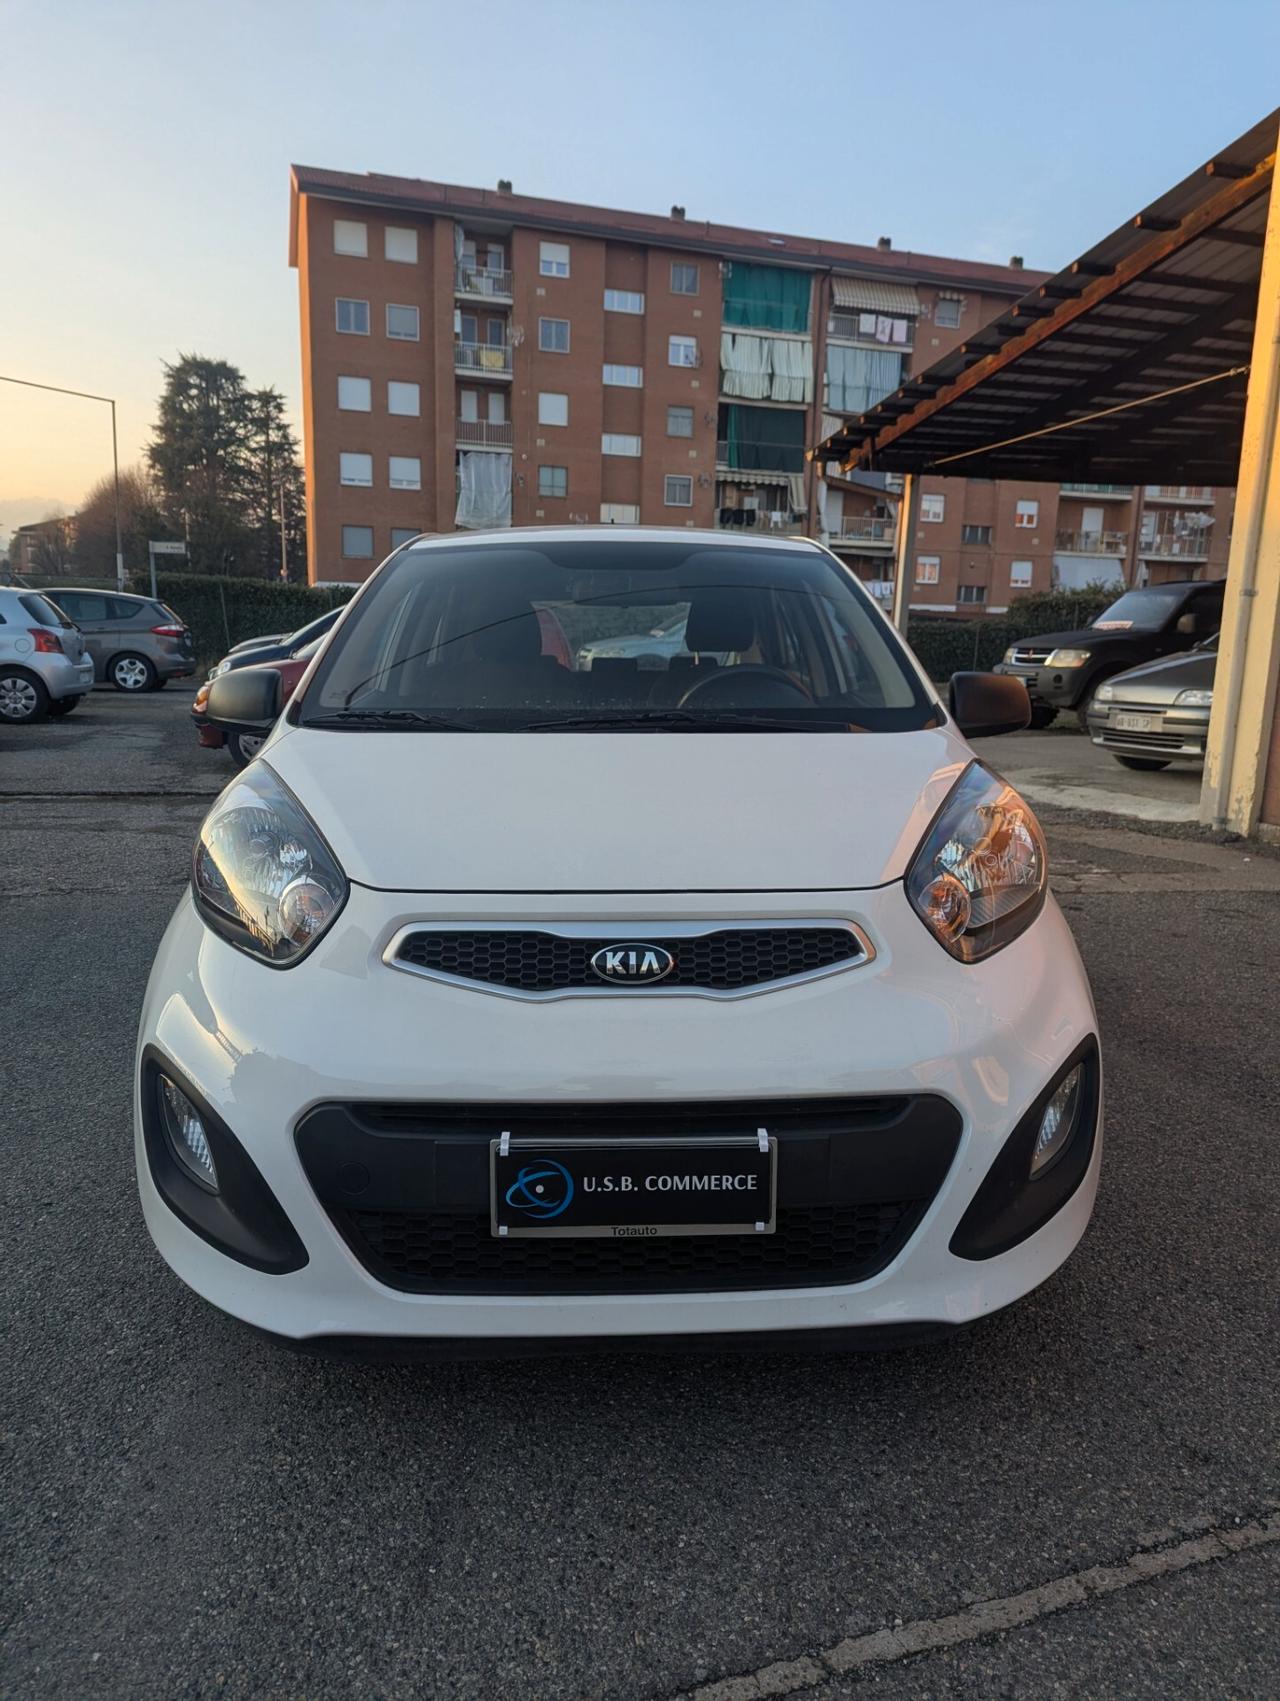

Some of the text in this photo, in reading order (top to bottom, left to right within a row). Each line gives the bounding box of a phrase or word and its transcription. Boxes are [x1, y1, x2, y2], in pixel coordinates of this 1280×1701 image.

[605, 951, 661, 974] KIA
[583, 1175, 758, 1191] U.S.B. COMMERCE
[611, 1226, 658, 1236] Totauto
